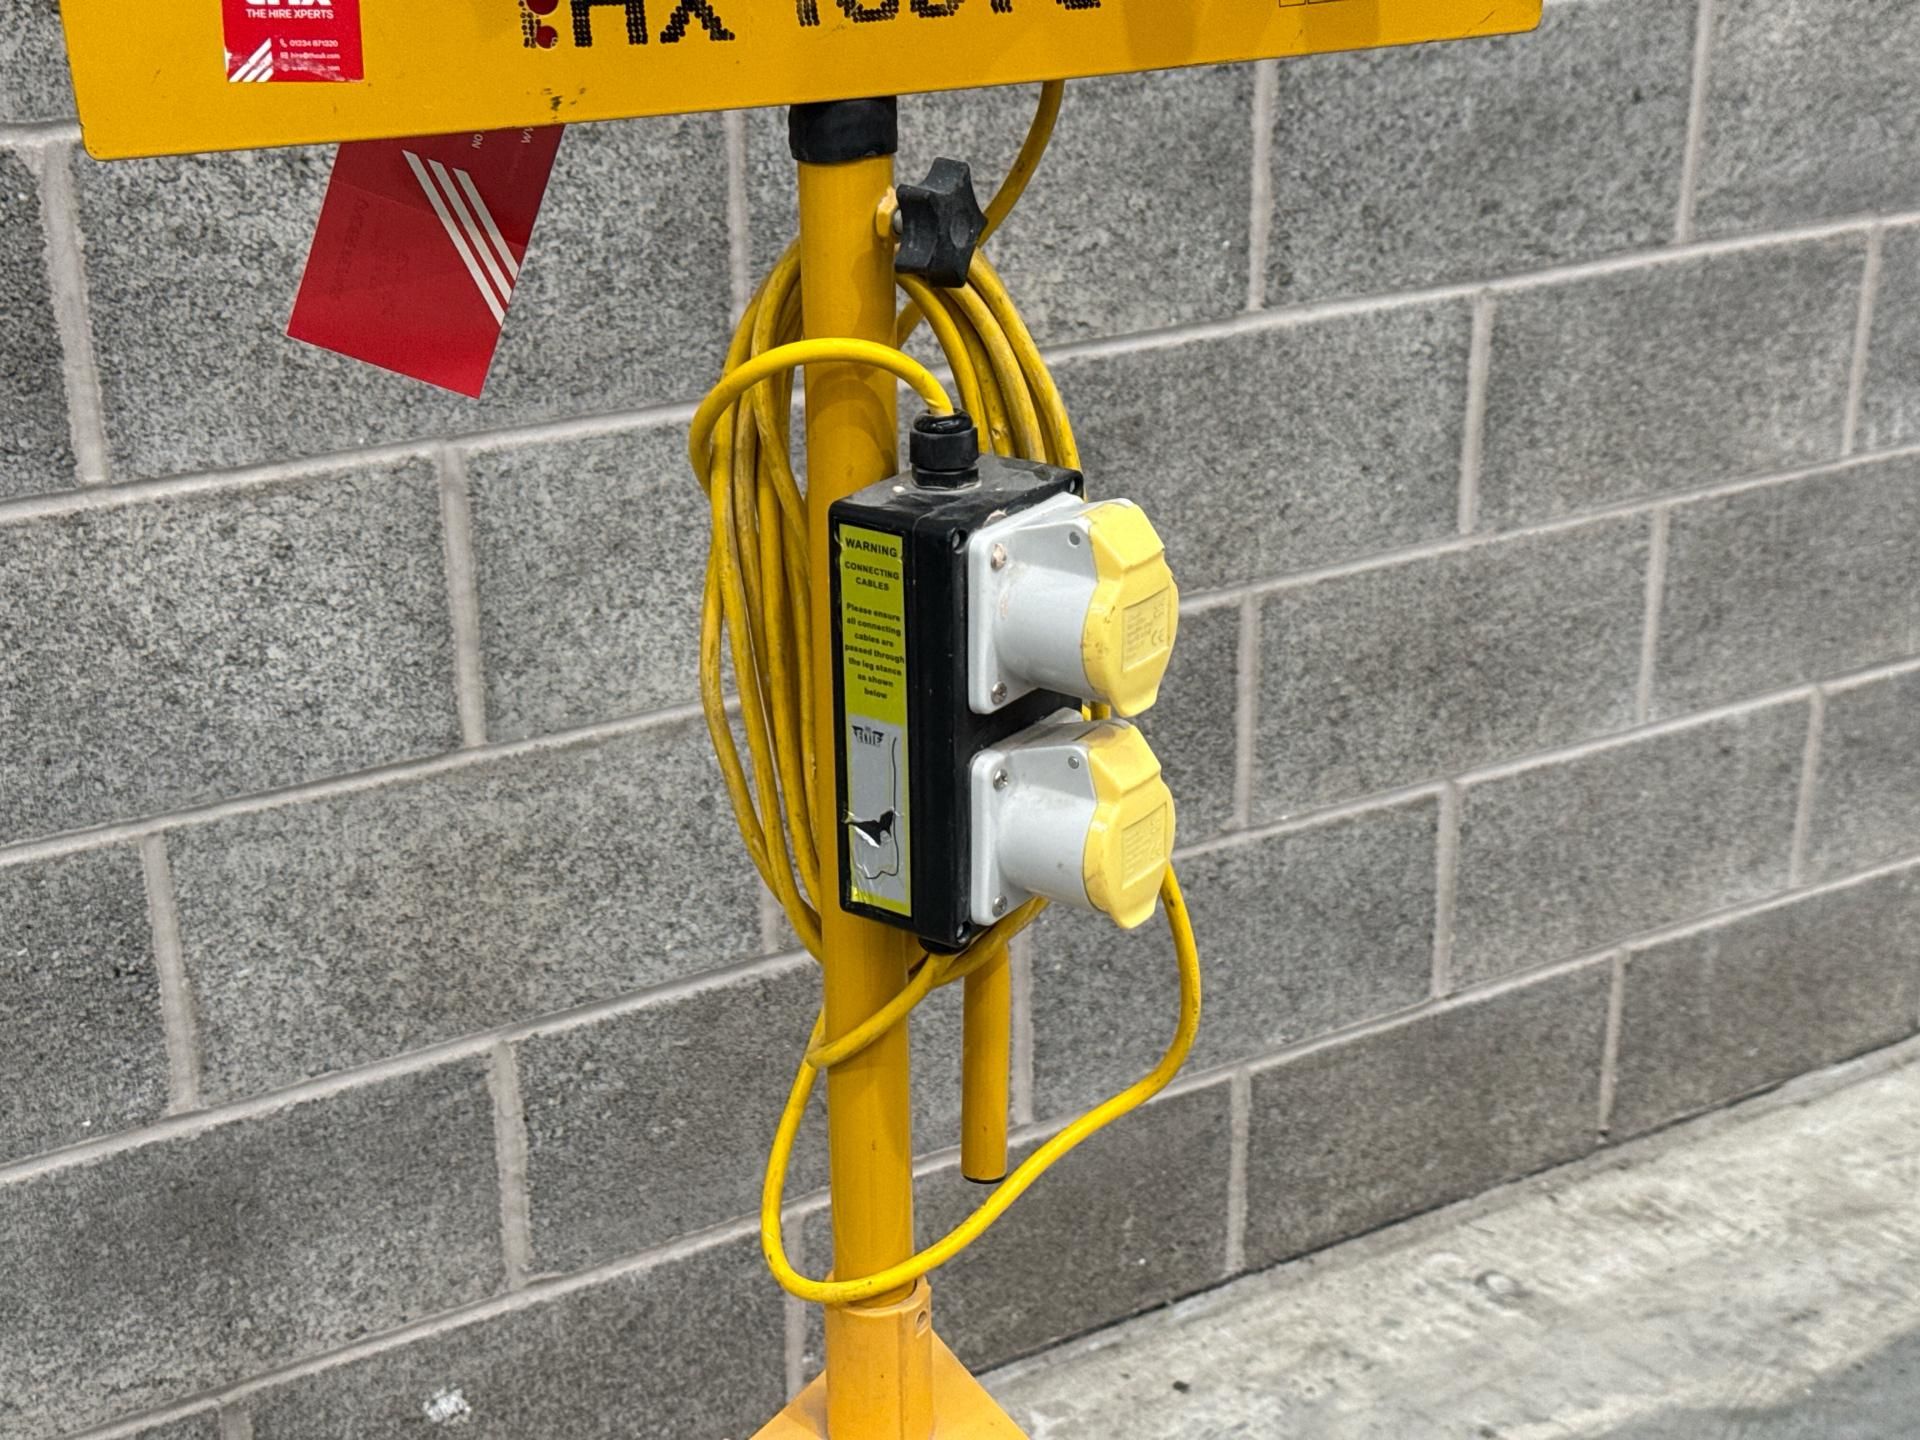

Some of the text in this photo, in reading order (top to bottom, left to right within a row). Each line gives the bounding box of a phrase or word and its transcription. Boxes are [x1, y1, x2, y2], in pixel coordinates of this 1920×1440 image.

[245, 8, 334, 19] THE HIRE XPERTS
[845, 537, 897, 557] WARNING
[844, 561, 899, 580] CONNECTING
[855, 577, 889, 591] CABLES
[846, 602, 901, 622] Please ensure
[846, 616, 901, 637] all connecting
[854, 633, 894, 648] cables are
[844, 644, 904, 664] passed through
[848, 656, 902, 676] the leg stance
[868, 675, 894, 687] shown
[863, 687, 888, 699] below
